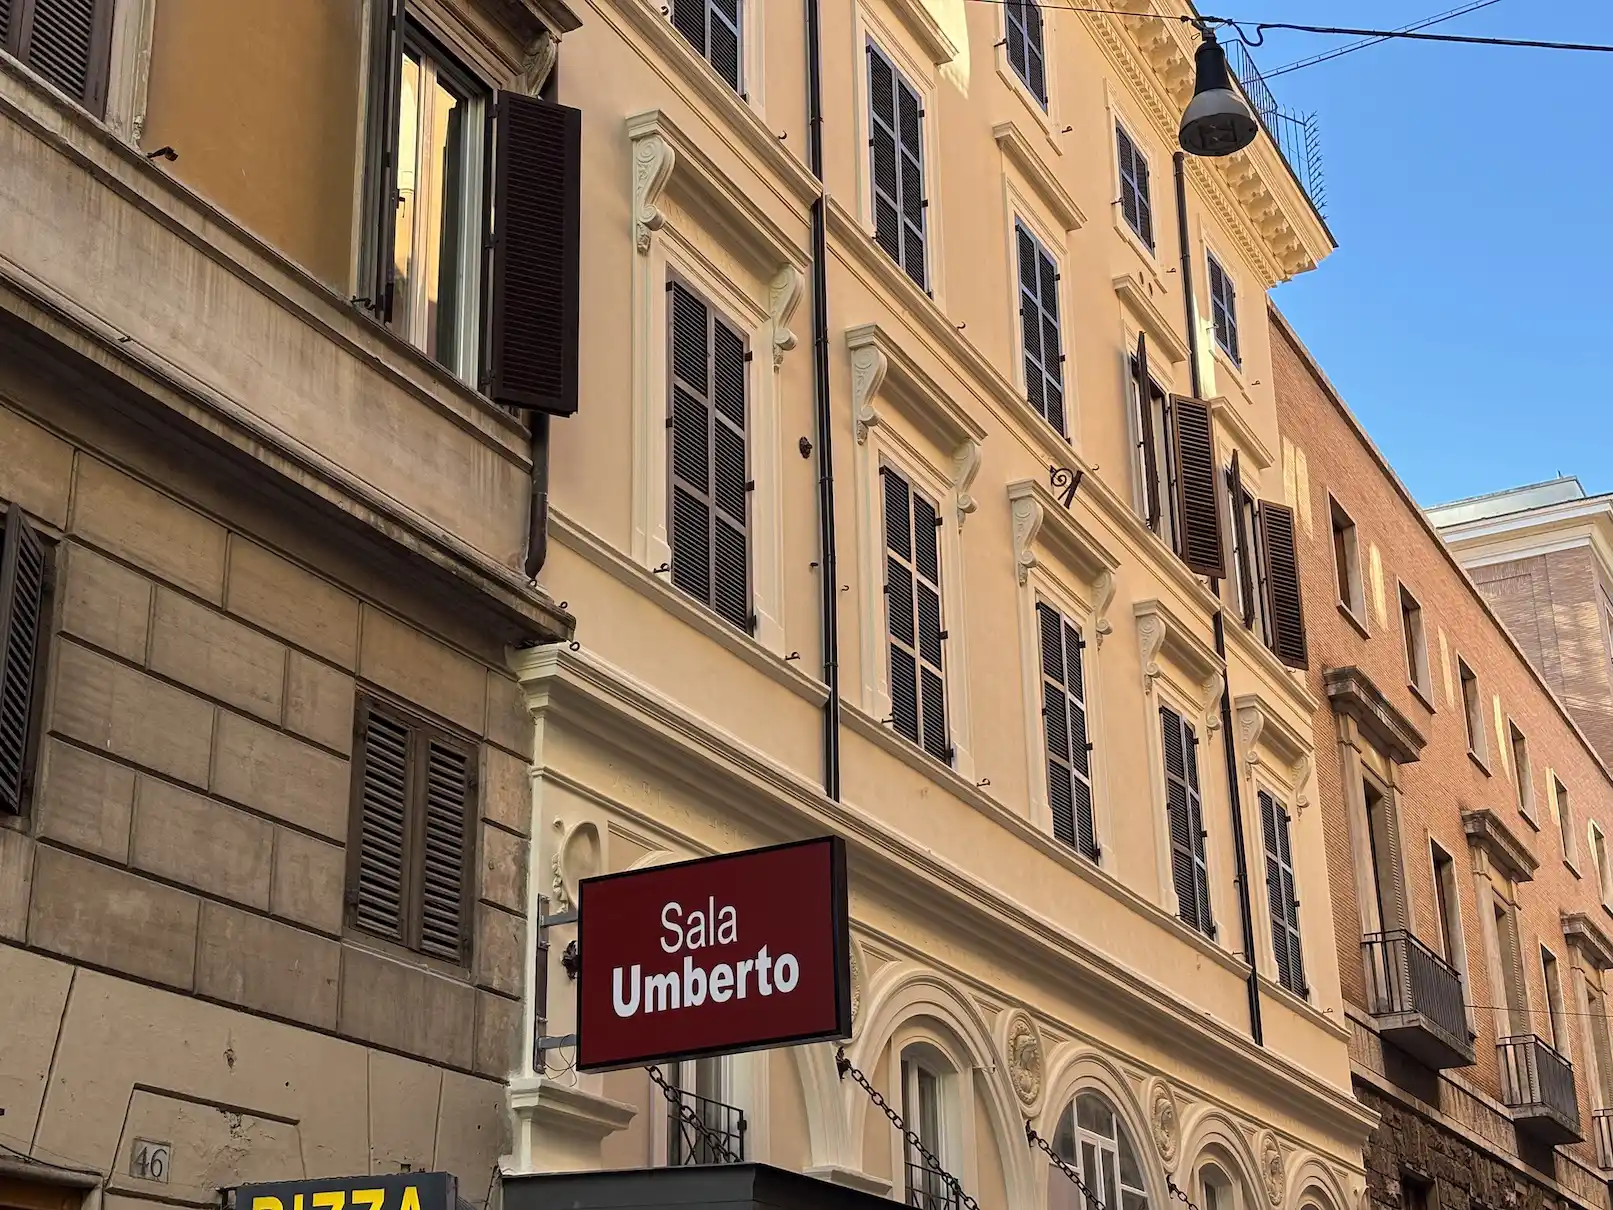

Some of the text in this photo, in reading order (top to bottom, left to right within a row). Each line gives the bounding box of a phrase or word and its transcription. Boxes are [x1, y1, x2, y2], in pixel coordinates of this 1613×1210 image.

[660, 895, 738, 953] Sala
[613, 943, 800, 1018] Umberto
[133, 1146, 168, 1178] 46
